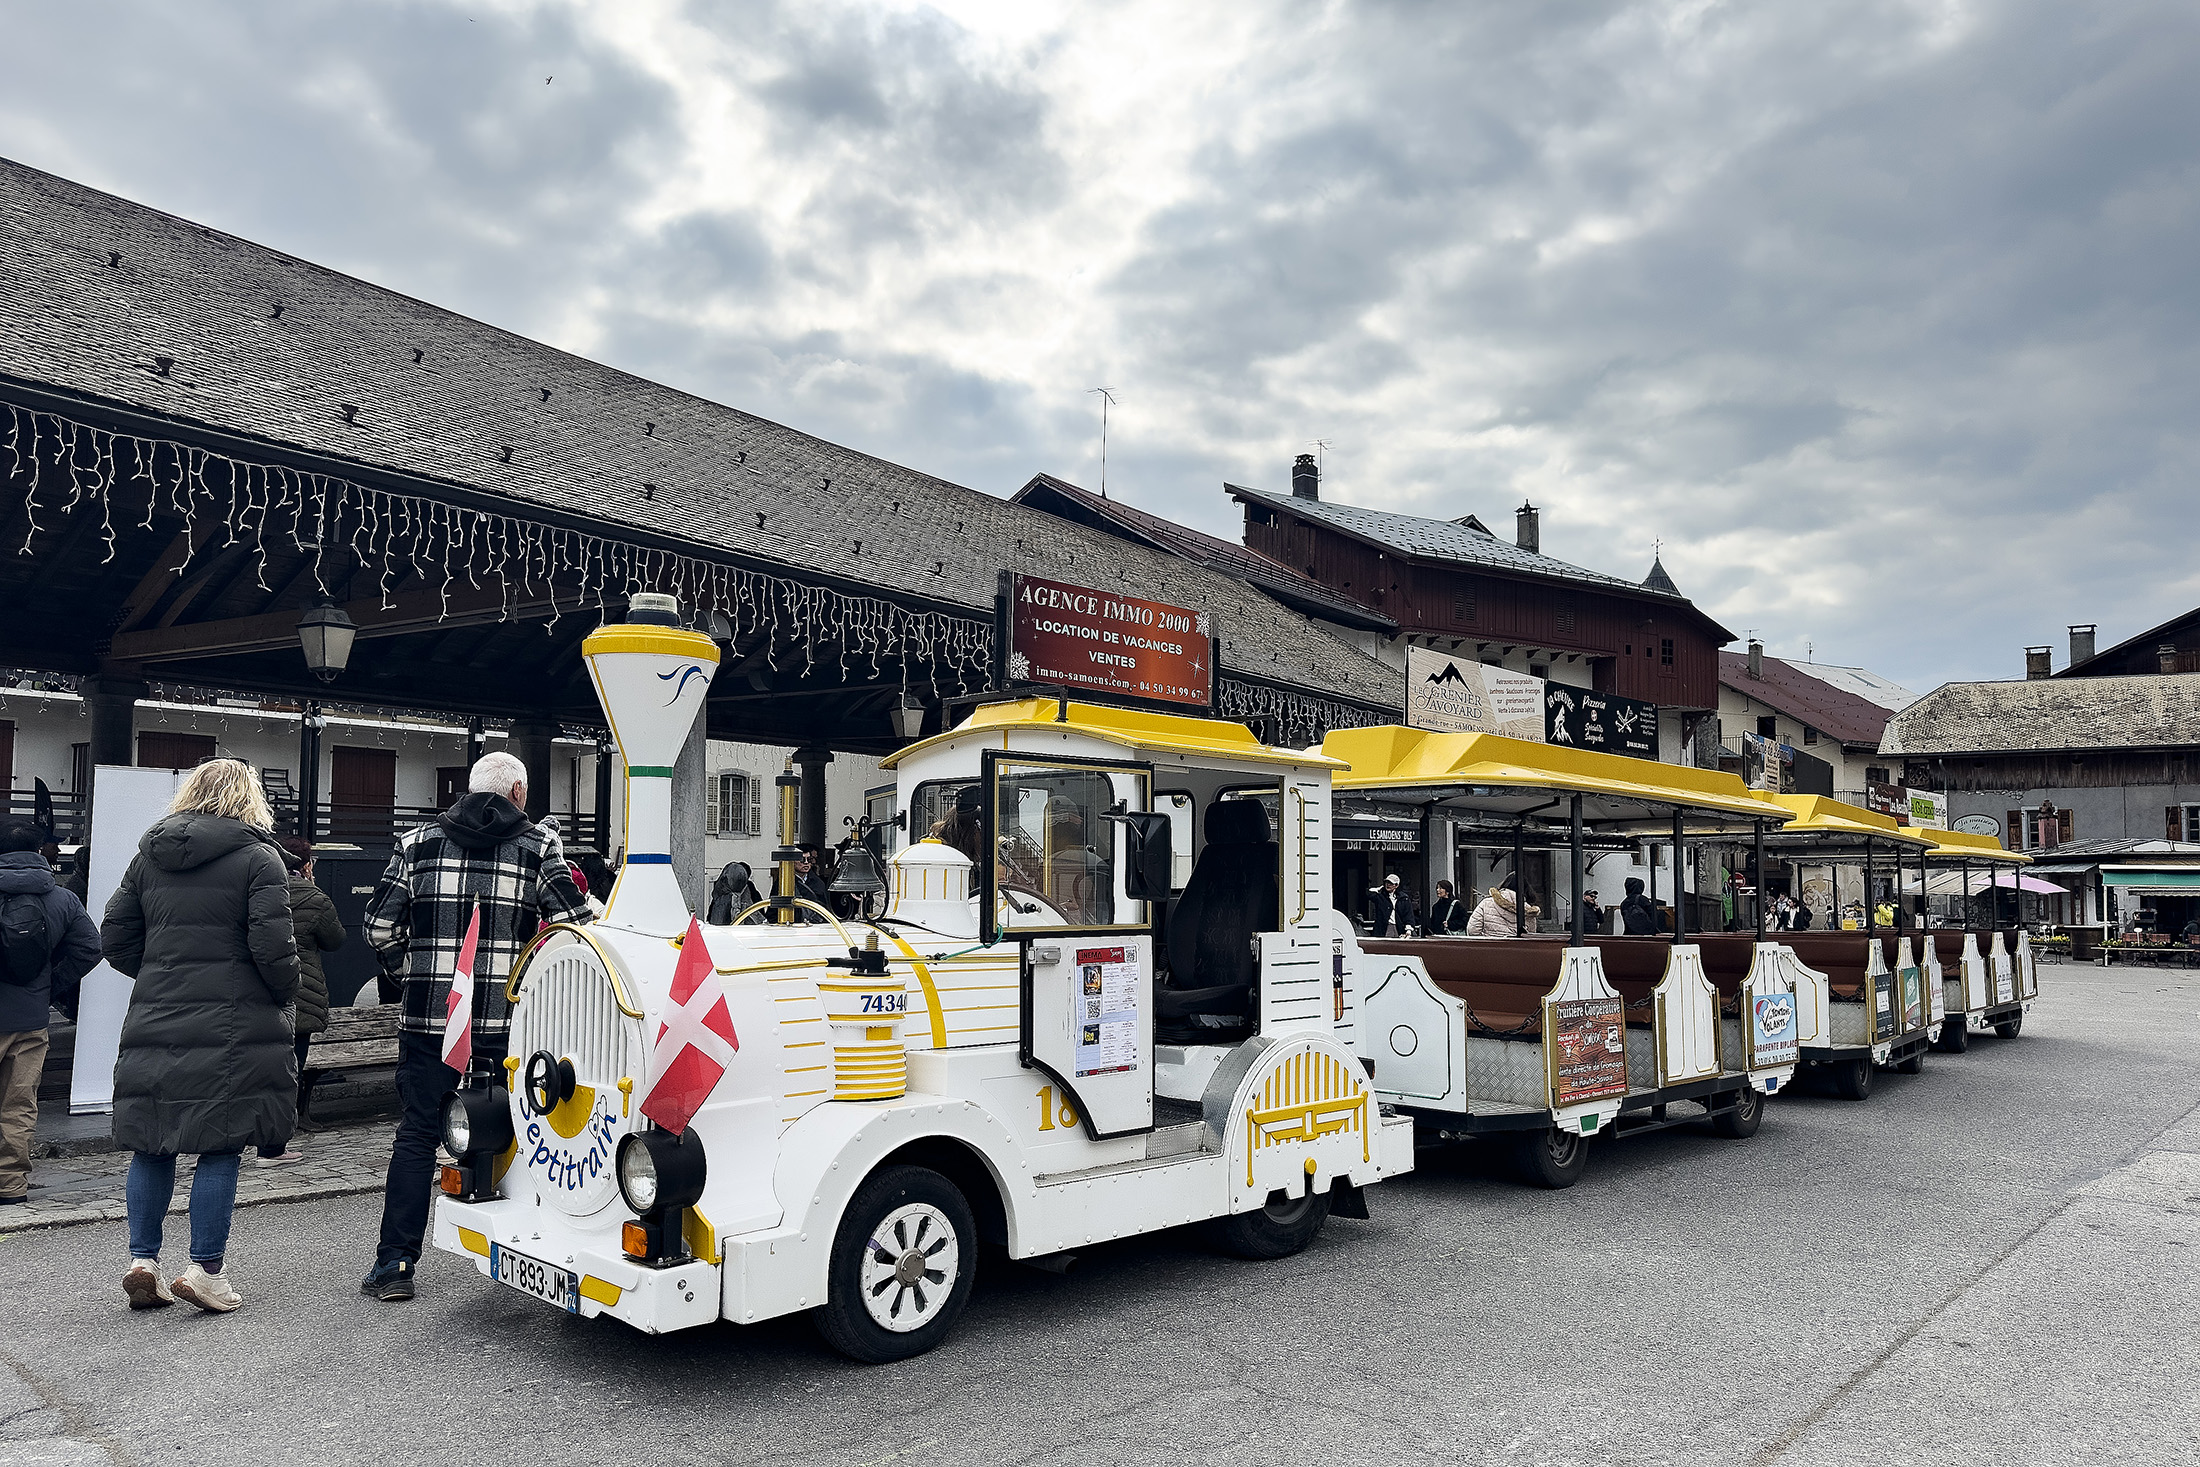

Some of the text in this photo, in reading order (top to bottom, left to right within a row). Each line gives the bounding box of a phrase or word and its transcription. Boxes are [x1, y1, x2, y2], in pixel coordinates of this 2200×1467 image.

[1020, 585, 1190, 634] AGENCE IMMO 2000
[1035, 618, 1183, 655] LOCATION DE VACANCES
[1088, 650, 1136, 669] VENTES
[1036, 665, 1201, 699] immo-samoens.com 04 50 34 99 67
[1414, 686, 1423, 695] LE
[1423, 686, 1482, 706] GRENIER
[1582, 695, 1606, 710] Pizzeria
[1414, 694, 1482, 719] SAVOYARD
[1370, 829, 1376, 839] LE
[1376, 829, 1401, 840] SAMOENS
[1584, 1001, 1620, 1019] Coopérative
[568, 1293, 576, 1310] 74
